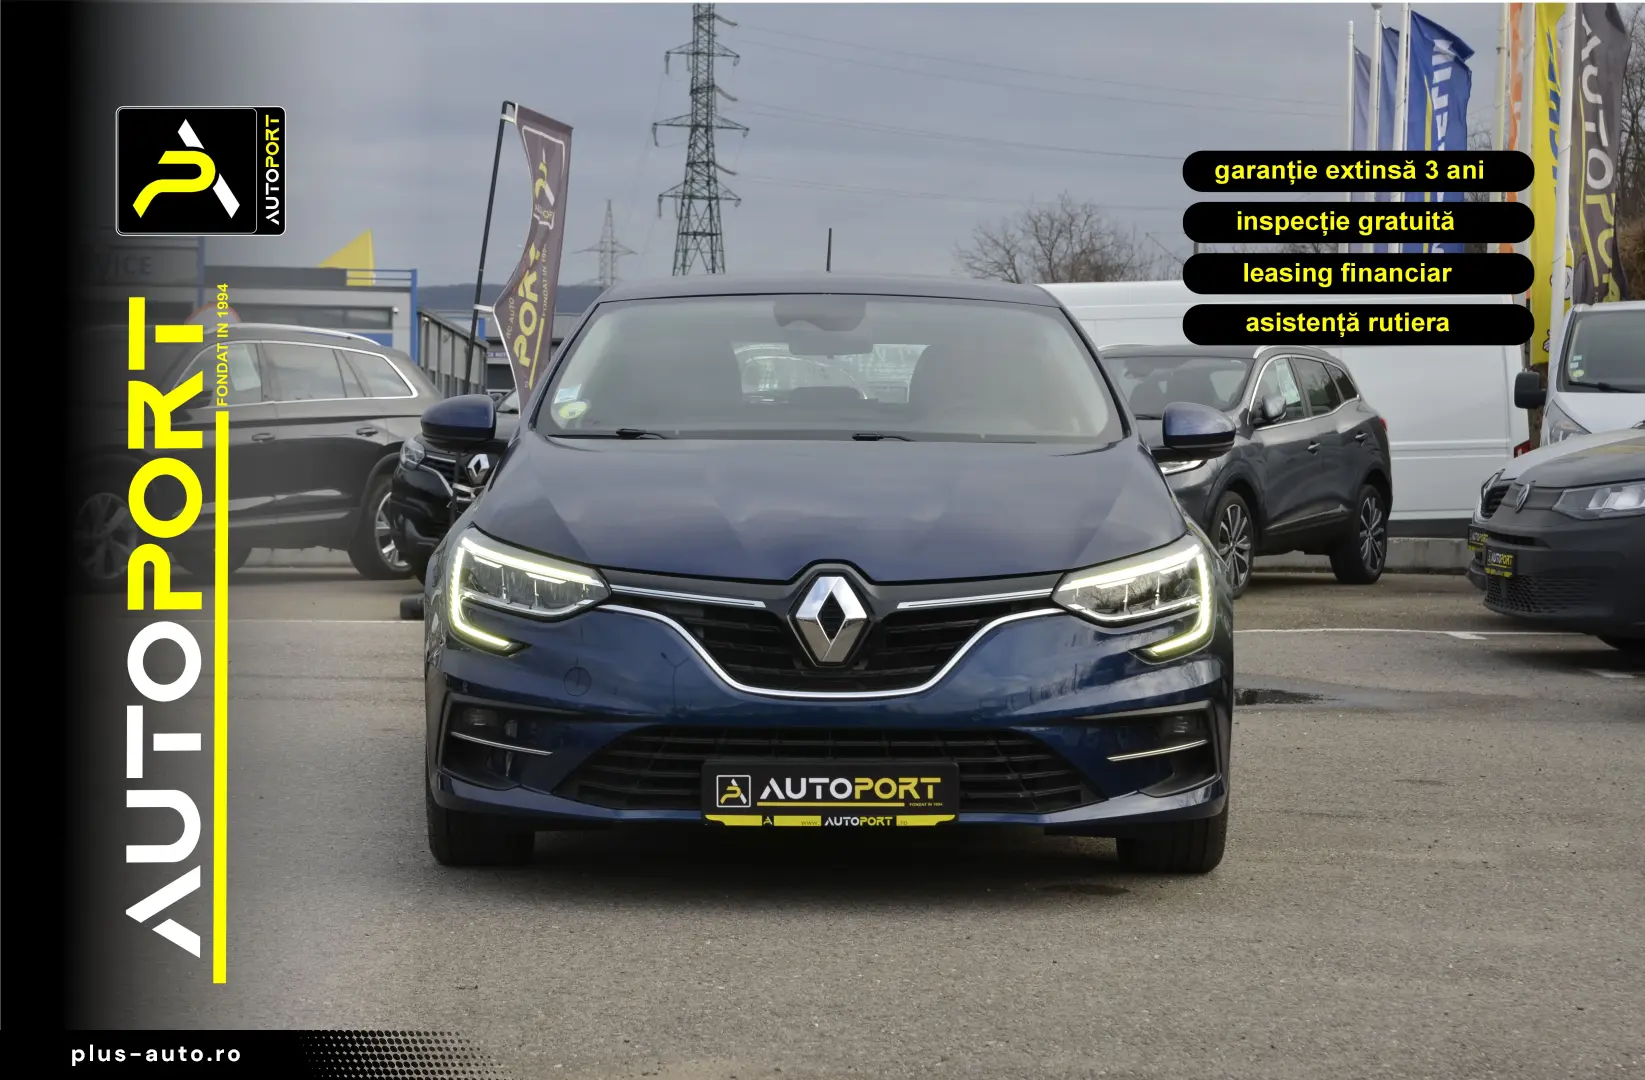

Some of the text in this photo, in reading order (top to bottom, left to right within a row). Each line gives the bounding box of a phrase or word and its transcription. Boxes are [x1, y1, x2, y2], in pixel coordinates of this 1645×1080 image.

[1581, 13, 1620, 301] AUTOPOR
[760, 777, 941, 800] AUTOPORT
[824, 816, 893, 827] AUTOPORT
